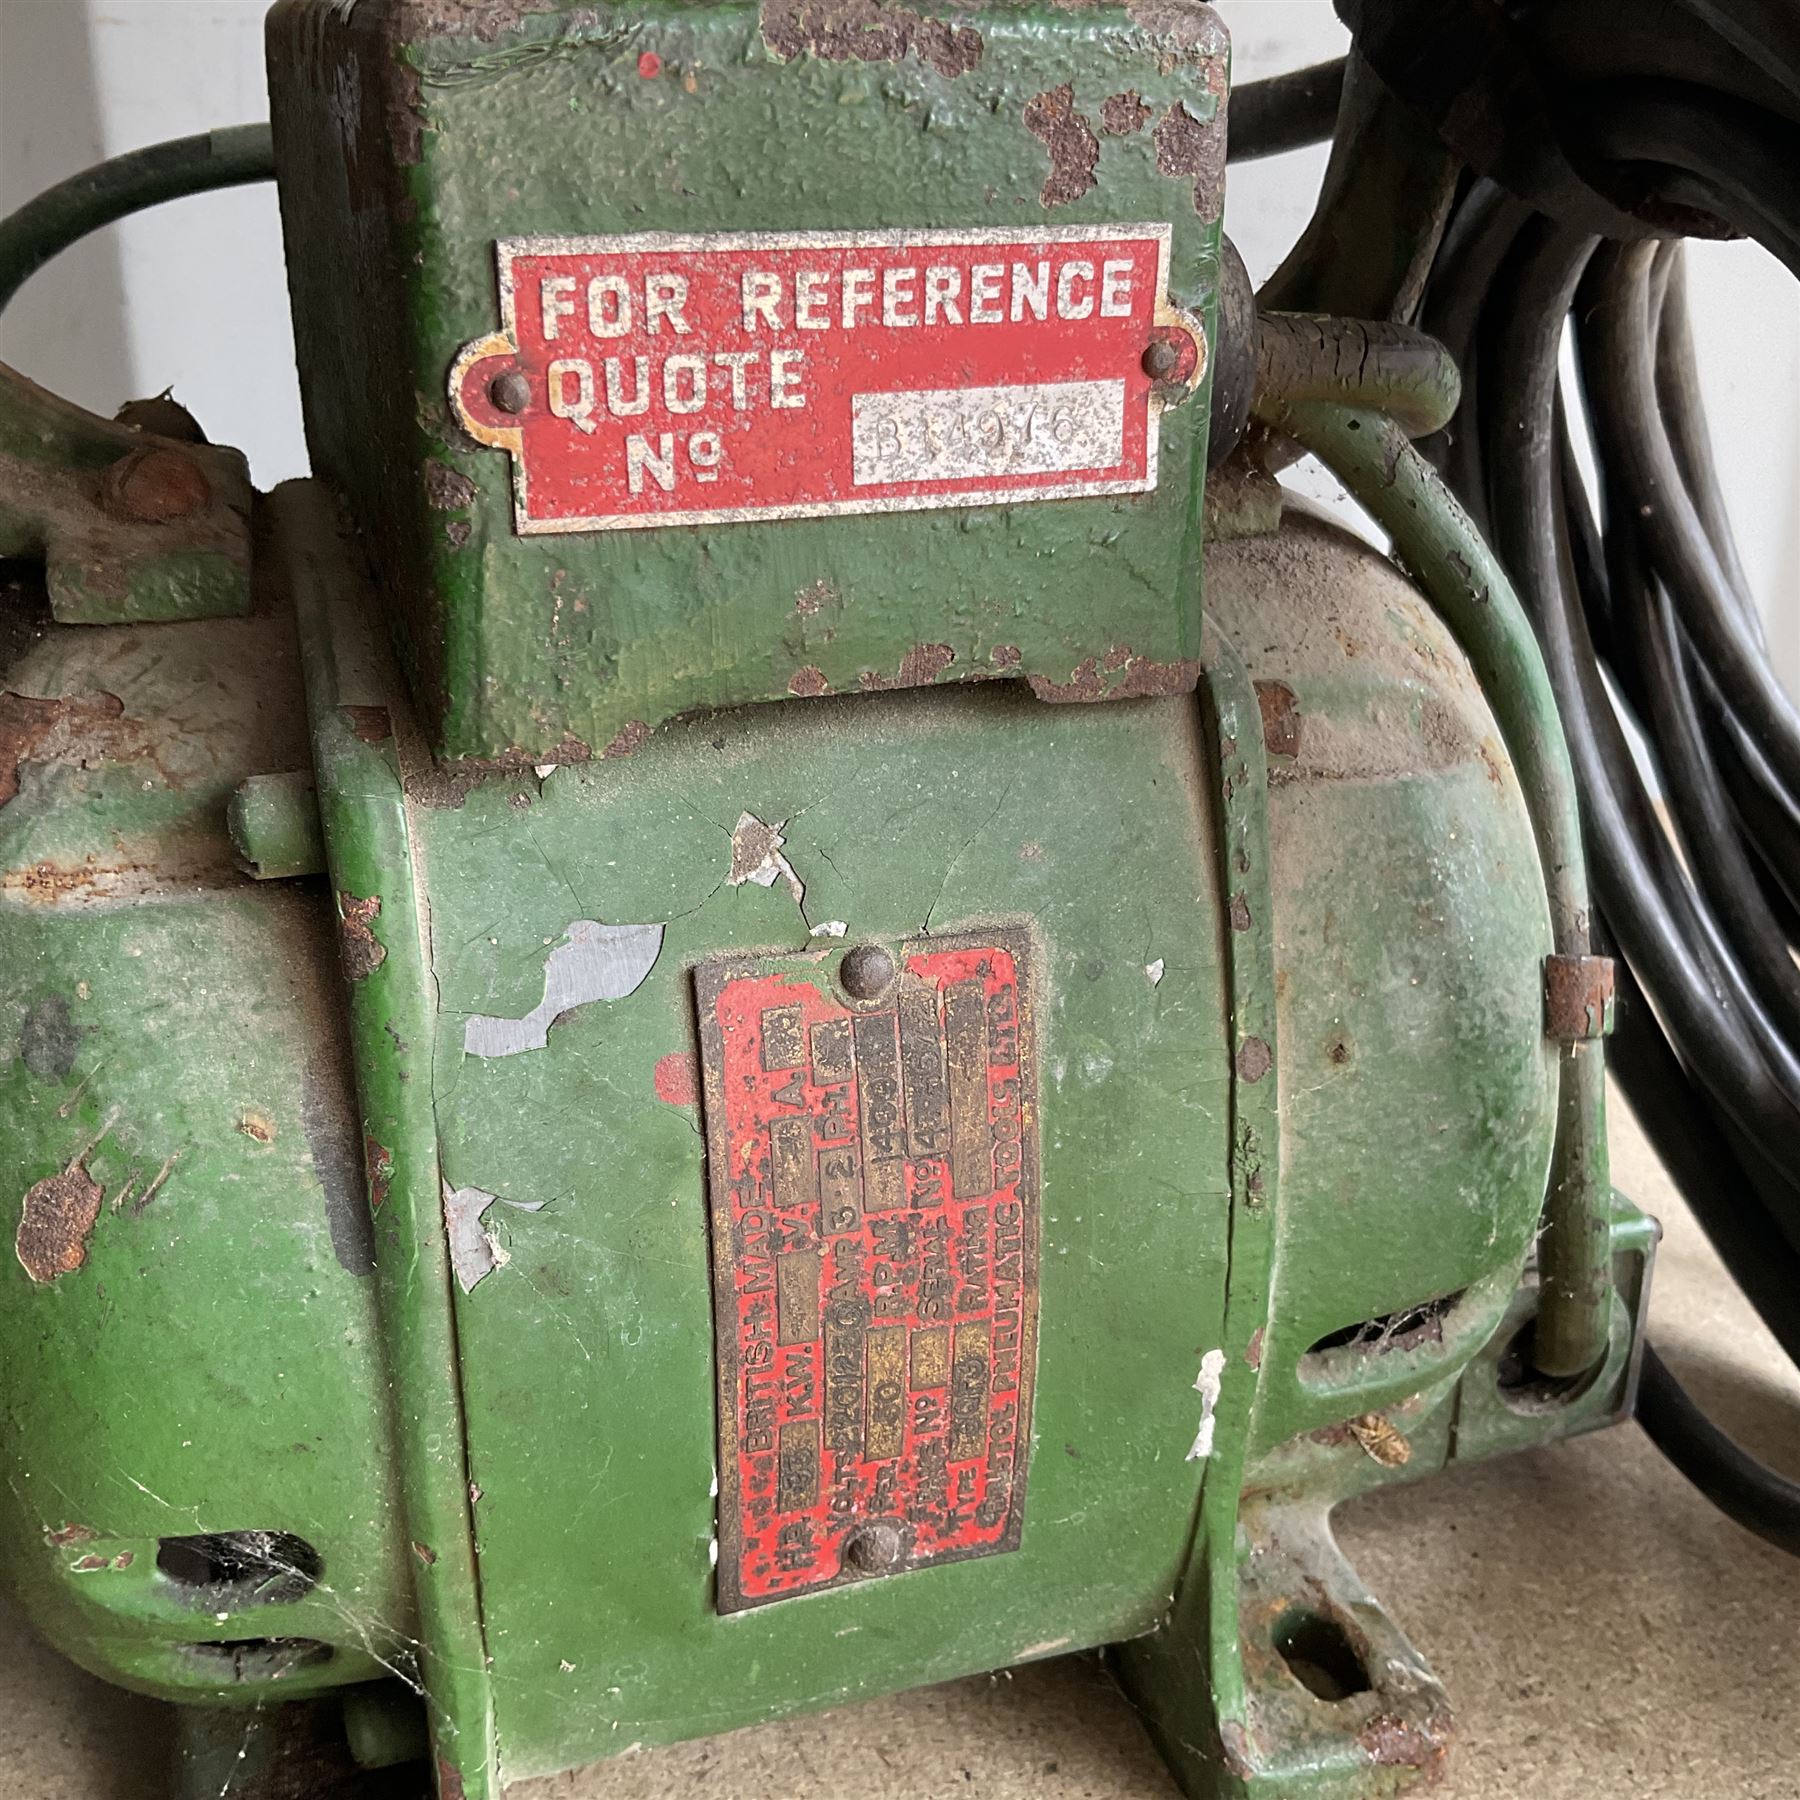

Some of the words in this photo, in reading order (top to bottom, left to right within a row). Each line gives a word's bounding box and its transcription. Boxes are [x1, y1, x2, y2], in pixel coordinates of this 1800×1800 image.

[541, 272, 691, 340] FOR
[742, 259, 1133, 332] REFERENCE
[547, 348, 806, 434] QUOTE
[992, 1078, 1020, 1189] TOOLS
[739, 1181, 772, 1293] MADE
[917, 1214, 949, 1319] SERIAL
[956, 1206, 988, 1312] RATING
[992, 1202, 1021, 1391] PNEUMATIC
[744, 1312, 775, 1452] BRITISH
[785, 1345, 813, 1416] K.W.
[946, 1467, 976, 1531] TYPE
[982, 1400, 1015, 1513] BRISTOL
